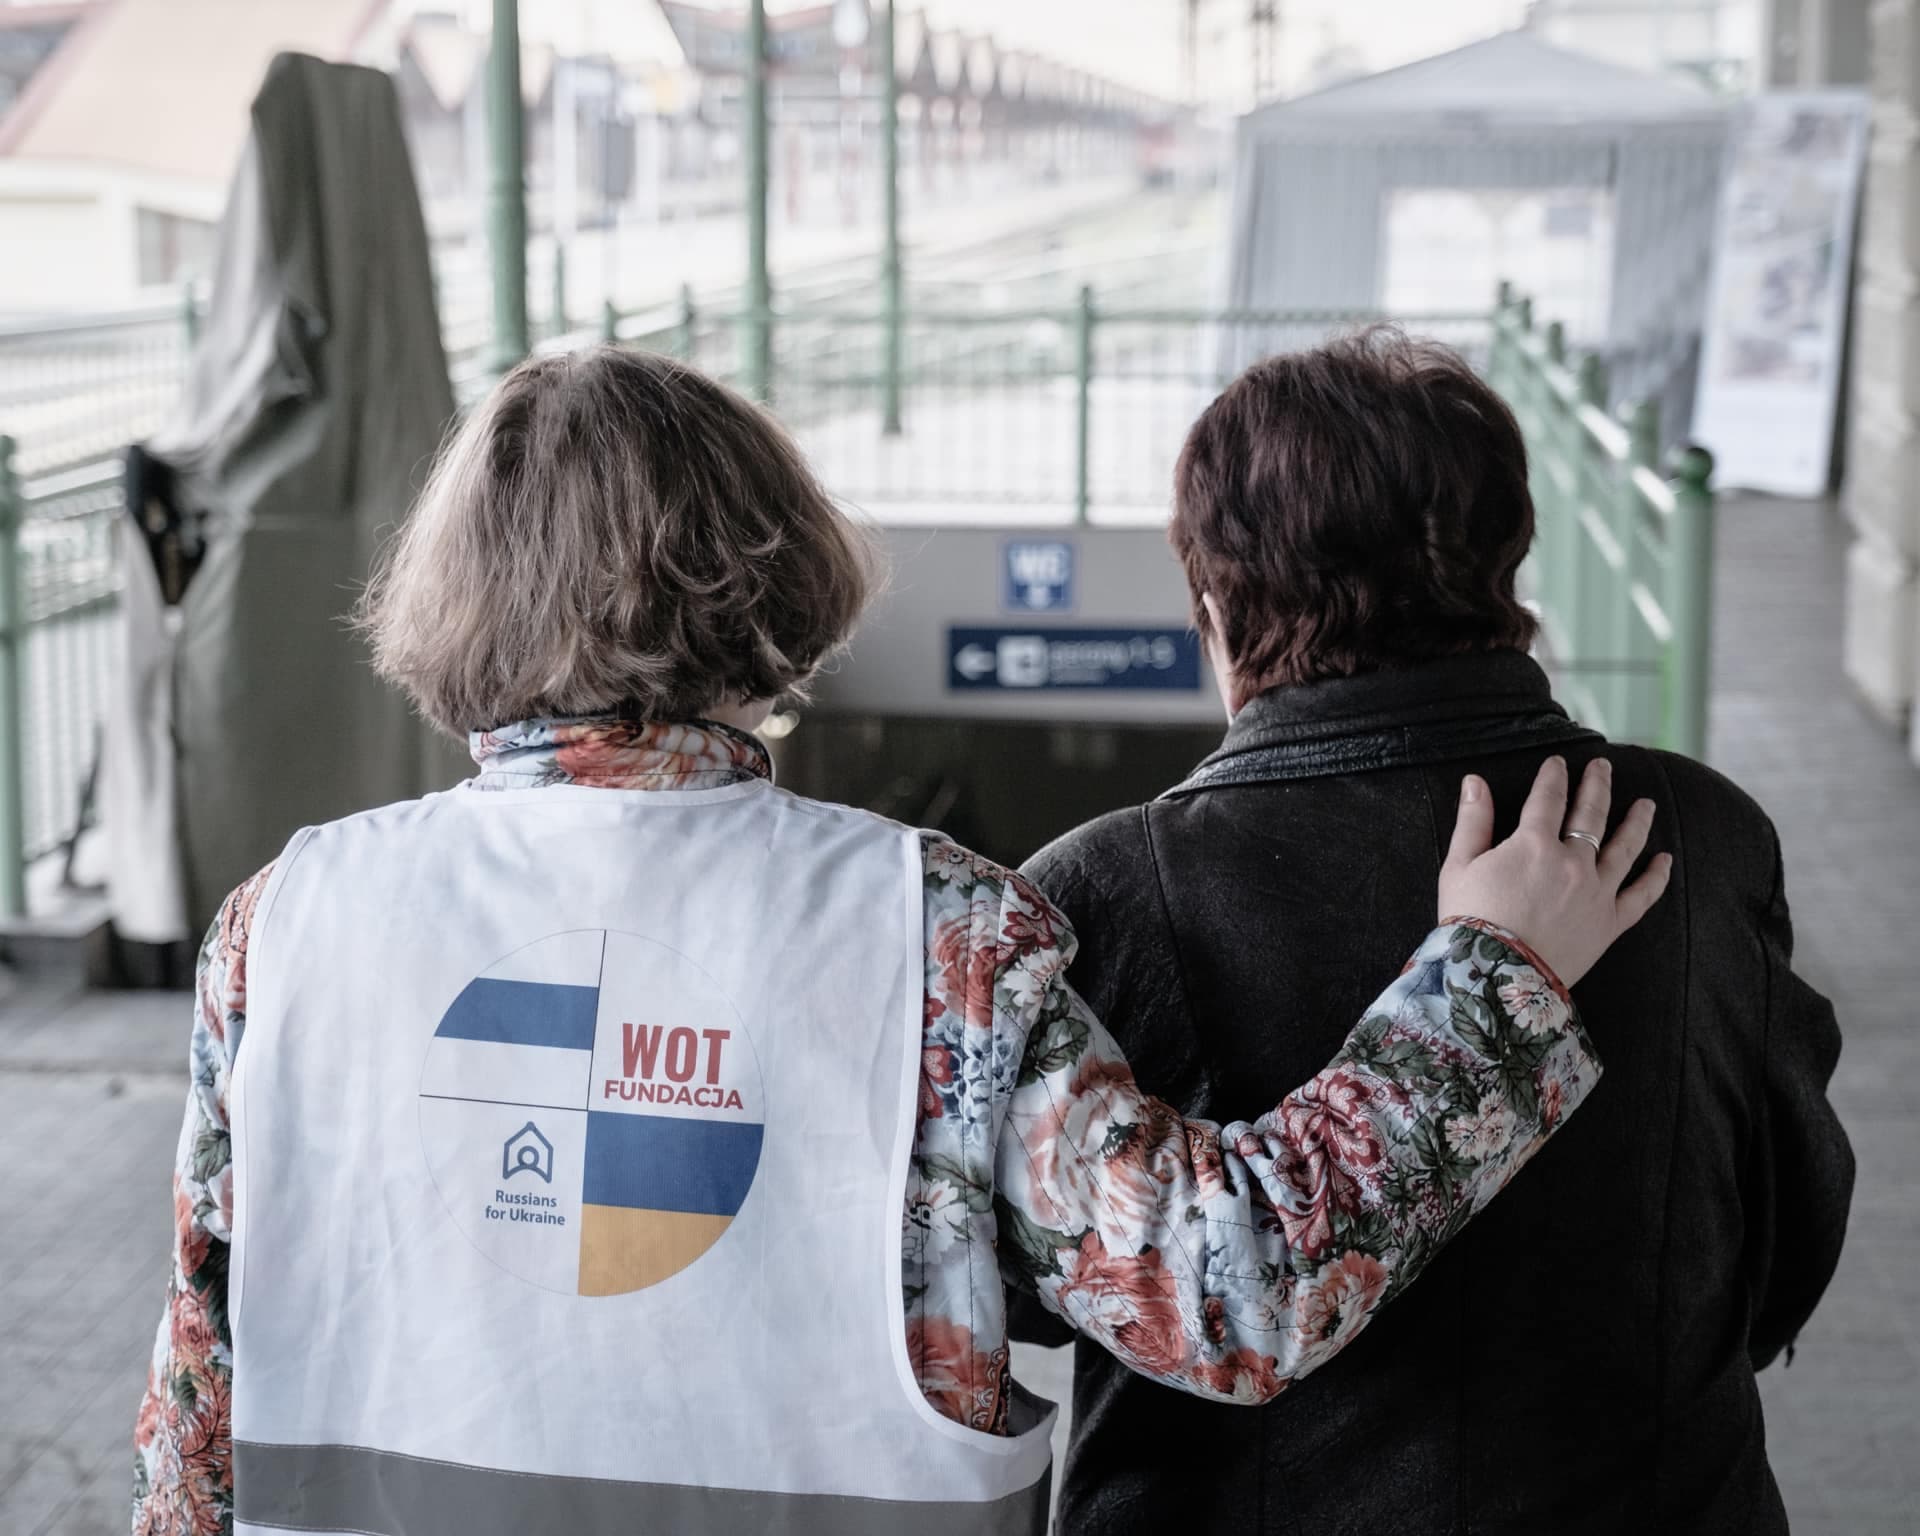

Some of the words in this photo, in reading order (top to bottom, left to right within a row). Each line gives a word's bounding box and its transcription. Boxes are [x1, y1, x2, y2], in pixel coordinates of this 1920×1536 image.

[623, 1023, 730, 1085] WOT
[604, 1079, 744, 1110] FUNDACJA
[495, 1189, 557, 1208] Russians
[485, 1205, 506, 1220] for
[509, 1207, 566, 1226] Ukraine
